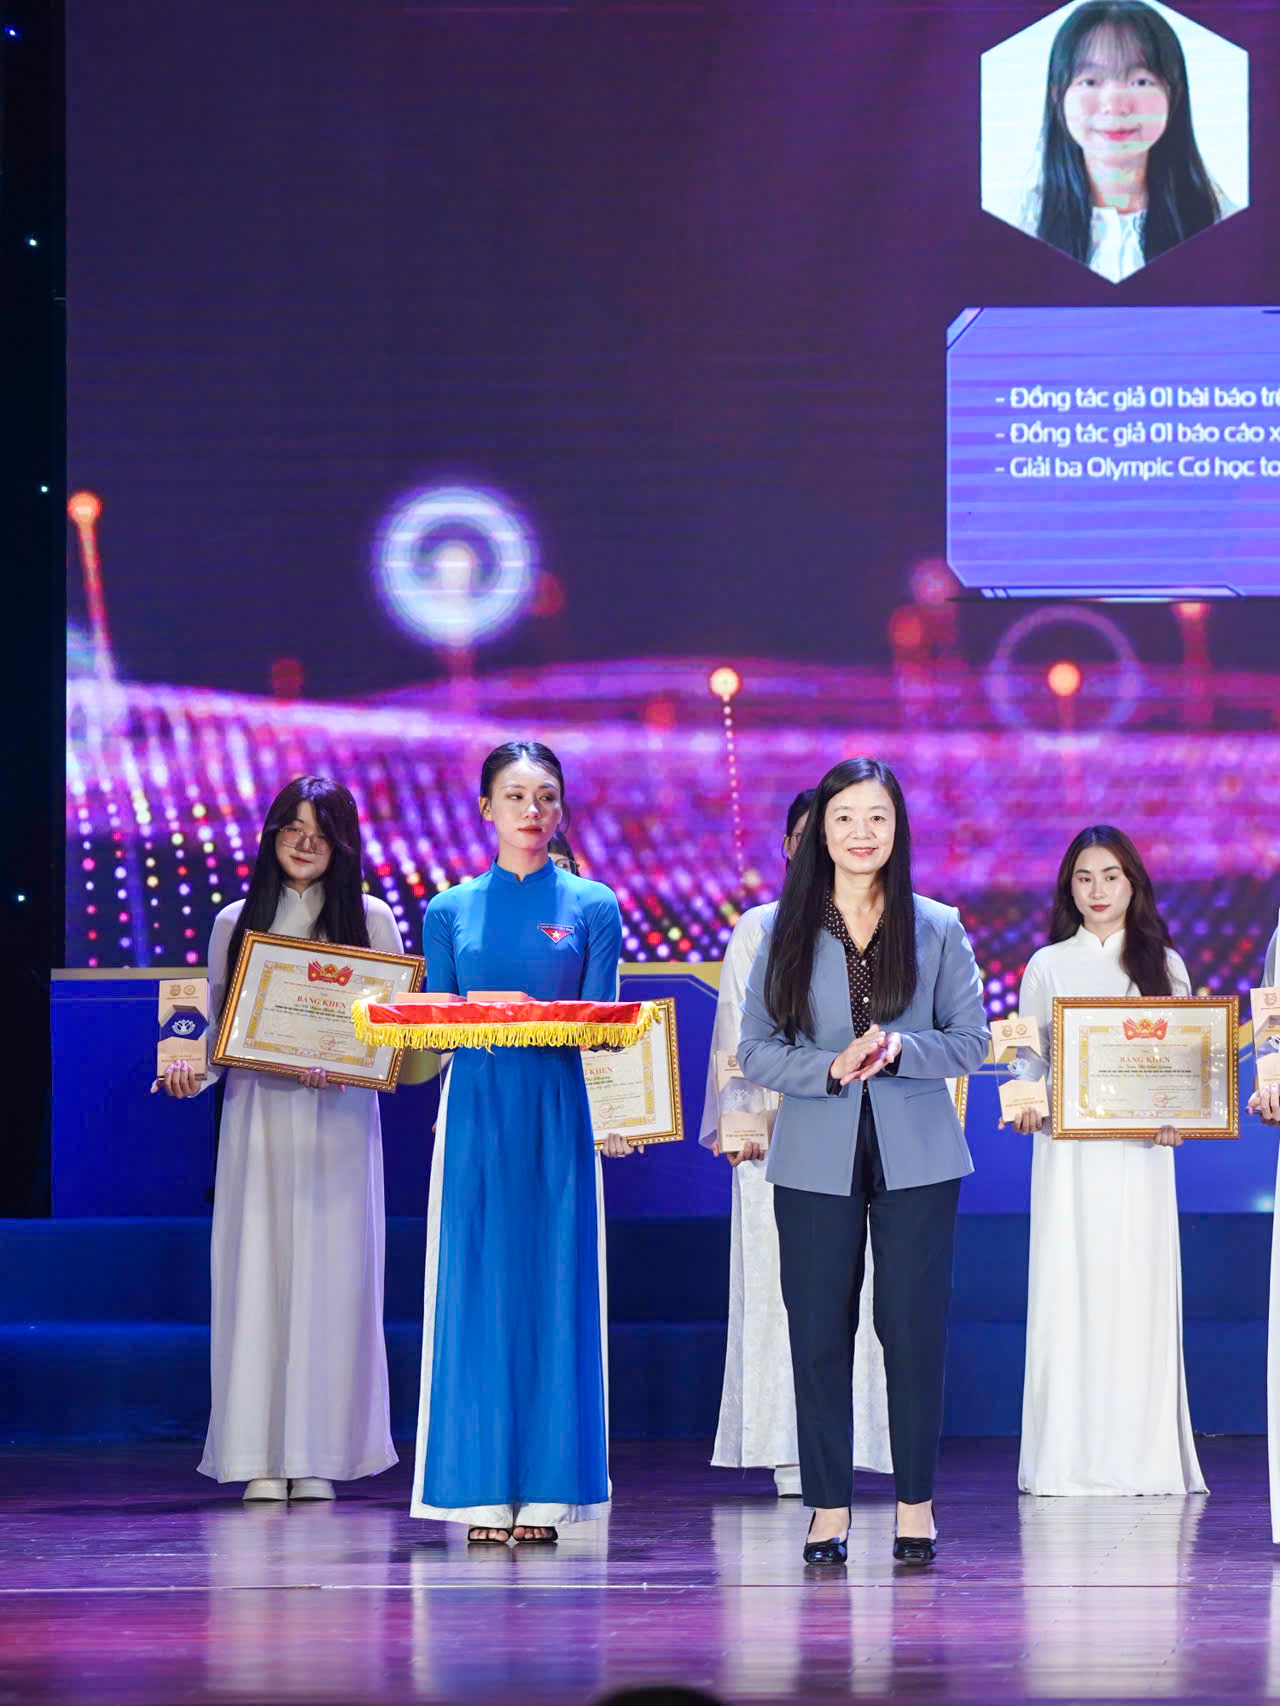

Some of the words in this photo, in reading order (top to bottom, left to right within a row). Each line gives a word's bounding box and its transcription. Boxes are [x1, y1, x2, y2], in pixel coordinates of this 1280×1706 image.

[1009, 386, 1072, 411] Đồng
[1075, 388, 1109, 408] tác
[1113, 387, 1145, 411] giả
[1150, 387, 1173, 408] 01
[1177, 386, 1210, 408] bài
[1214, 386, 1257, 407] báo
[1009, 421, 1071, 447] Đồng
[1075, 423, 1109, 444] tác
[1113, 421, 1146, 447] giả
[1150, 422, 1173, 444] 01
[1177, 422, 1220, 444] báo
[1224, 423, 1265, 443] cáo
[1009, 455, 1051, 478] Giải
[1055, 457, 1083, 478] ba
[1087, 456, 1174, 481] Olympic
[1178, 456, 1211, 477] Cơ
[1214, 456, 1256, 479] học
